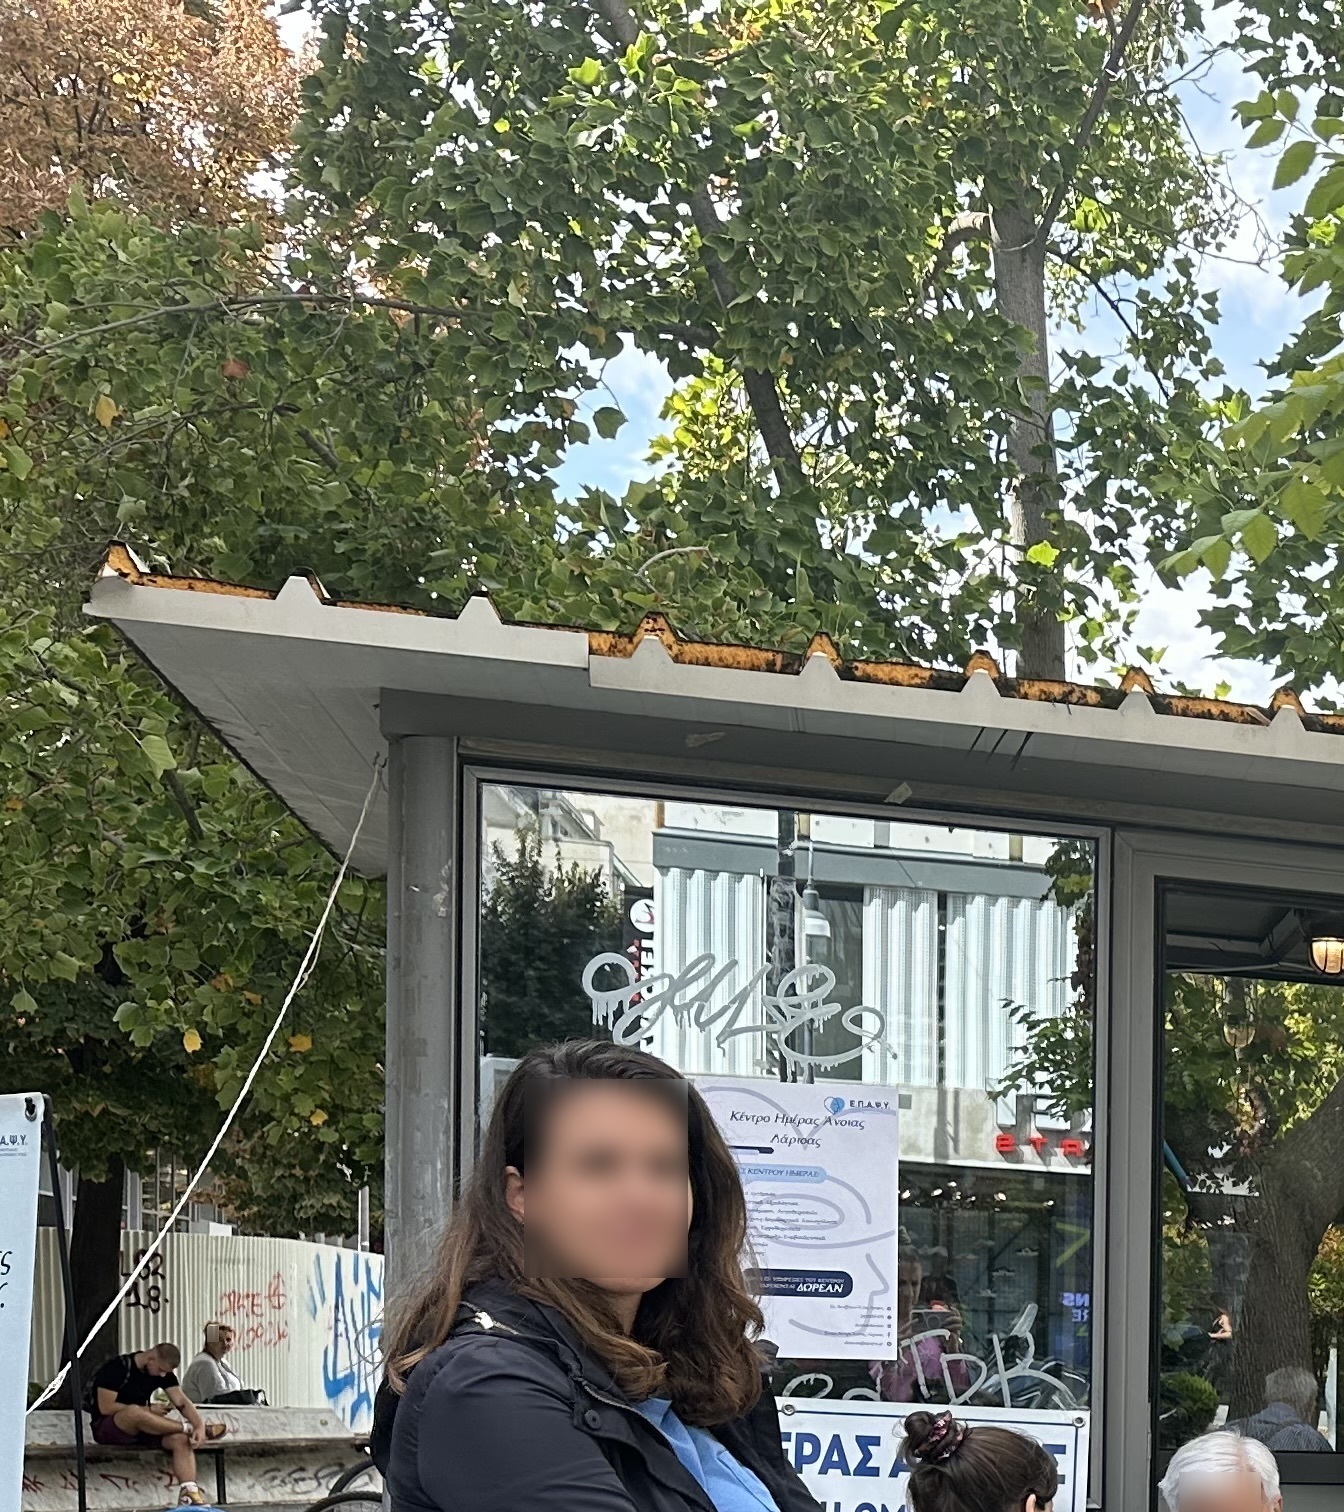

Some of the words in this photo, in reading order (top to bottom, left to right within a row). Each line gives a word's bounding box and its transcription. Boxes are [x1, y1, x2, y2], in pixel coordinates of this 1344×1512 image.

[729, 1111, 771, 1124] Κέντρο
[774, 1113, 820, 1127] Ημέρας
[822, 1115, 865, 1130] Άνοιας
[770, 1134, 822, 1148] Λάρισας
[796, 1282, 844, 1293] ΔΩΡΕΑΝ
